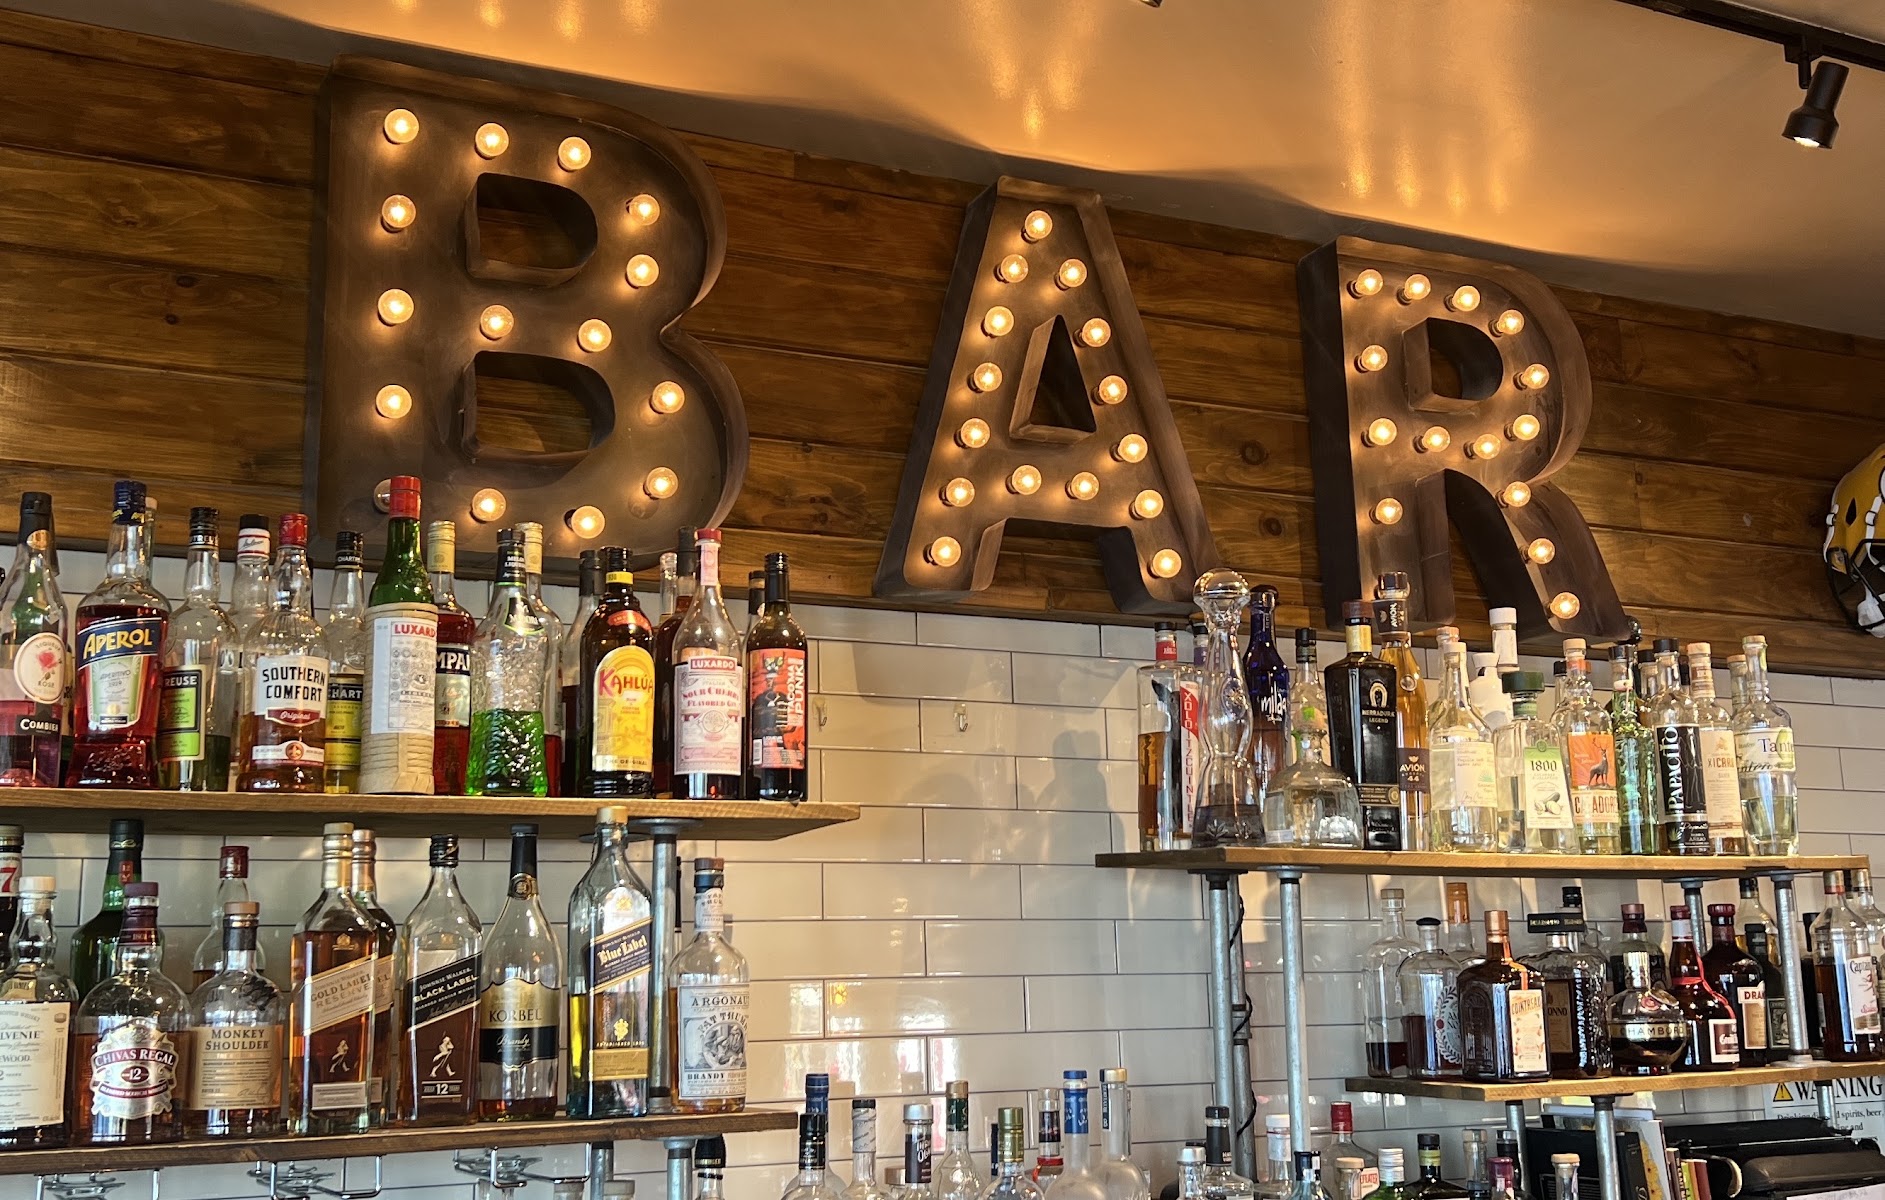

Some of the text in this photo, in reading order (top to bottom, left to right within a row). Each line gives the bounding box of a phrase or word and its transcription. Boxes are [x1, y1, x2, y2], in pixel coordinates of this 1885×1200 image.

[312, 57, 1637, 640] BAR
[83, 629, 153, 660] APEROL
[691, 659, 735, 670] LUXARDO
[263, 666, 326, 687] SOUTHERN
[266, 685, 323, 702] COMFORT
[280, 709, 311, 721] Original
[1530, 760, 1557, 772] 1800
[596, 934, 648, 967] Blue Label
[419, 966, 473, 992] JOHNNIE WALKER
[311, 986, 338, 1002] GOLD
[340, 973, 371, 990] LABEL
[316, 982, 370, 1008] RESERVE
[413, 973, 479, 1003] BLACK LABEL
[489, 1008, 542, 1022] KORBEL
[211, 1029, 265, 1040] MONKEY
[497, 1033, 530, 1049] Brandy
[205, 1040, 271, 1050] SHOULDER
[95, 1047, 175, 1068] CHIVAS REGAL
[129, 1069, 142, 1081] 12
[687, 1072, 725, 1080] BRANDY
[436, 1083, 449, 1095] 12
[1794, 1075, 1883, 1100] WANING
[1841, 1110, 1865, 1121] spirits,
[1852, 1122, 1864, 1131] and
